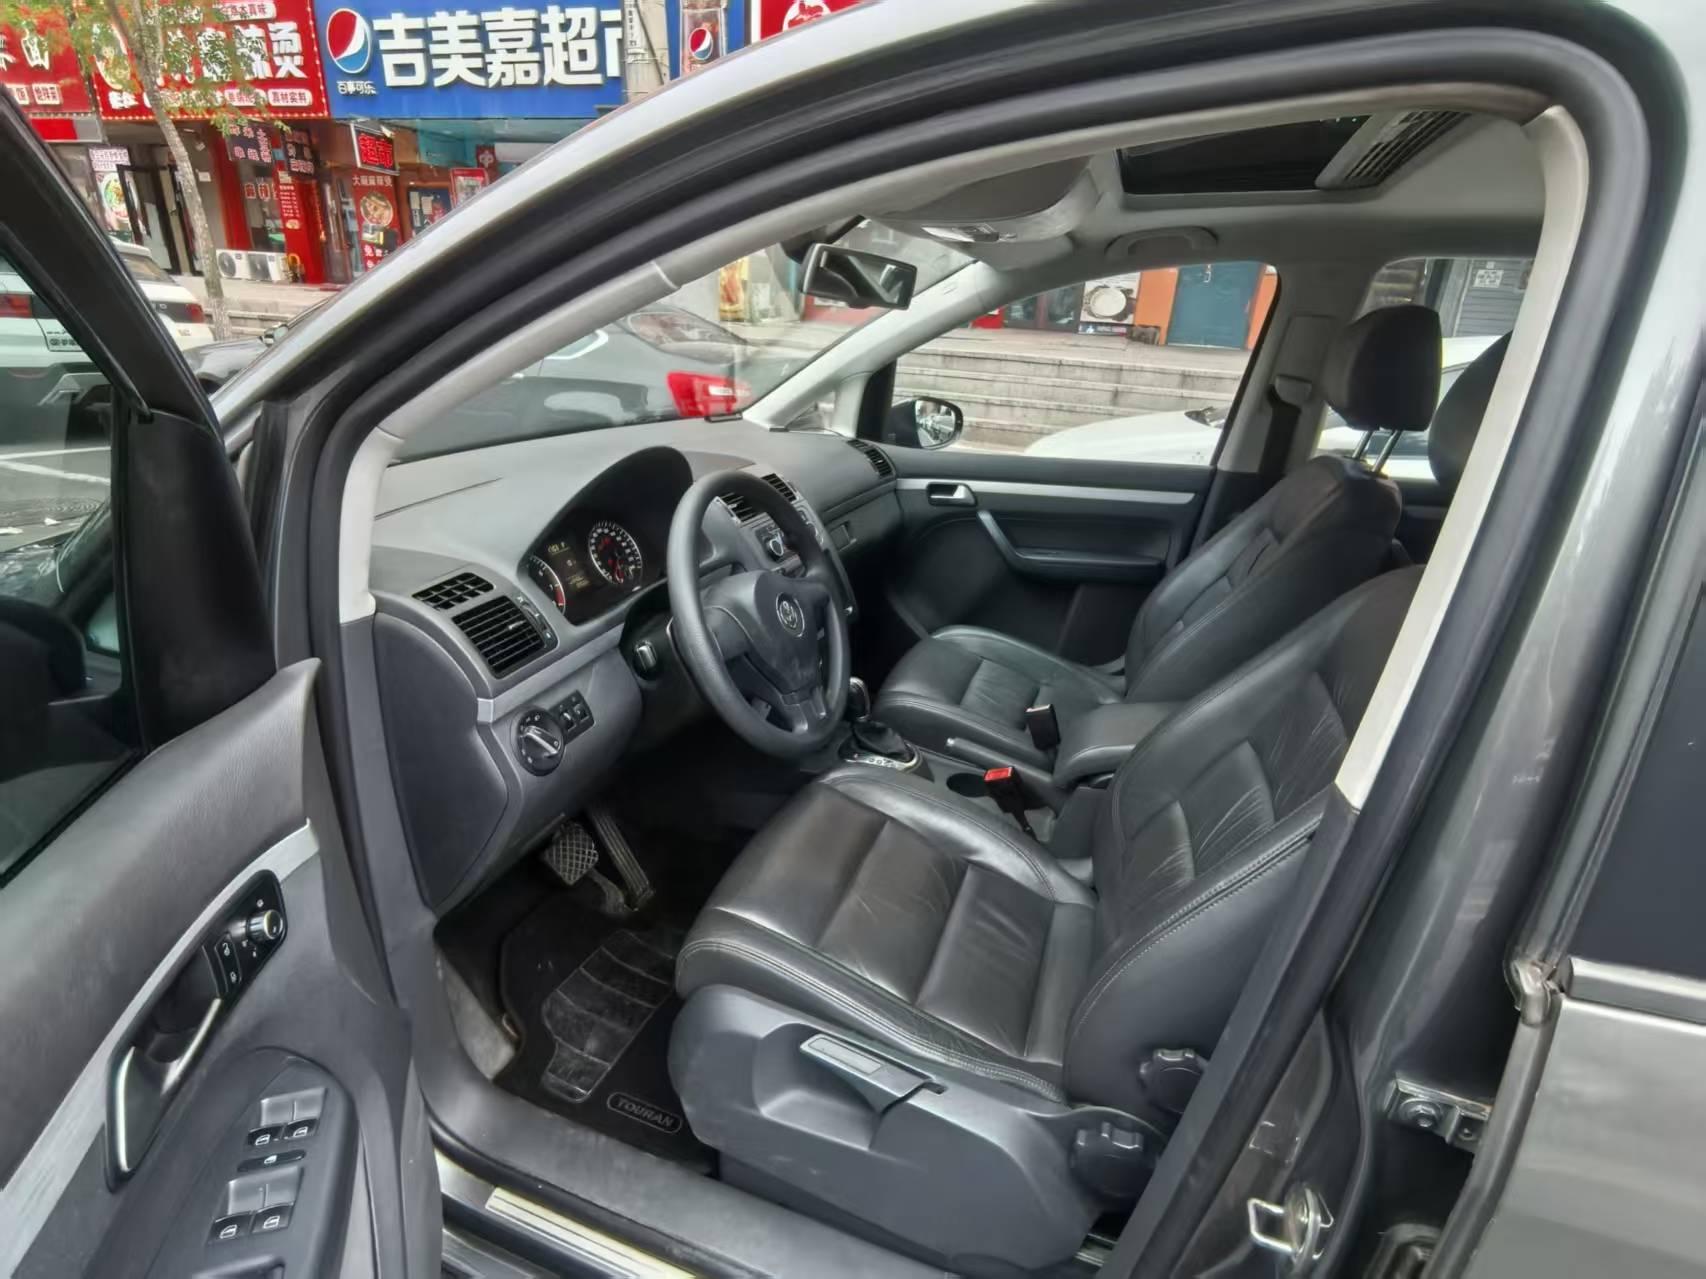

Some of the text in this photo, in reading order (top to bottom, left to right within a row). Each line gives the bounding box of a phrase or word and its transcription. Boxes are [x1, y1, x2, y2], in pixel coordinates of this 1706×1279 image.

[336, 80, 377, 95] 百事可乐
[617, 1098, 673, 1127] TOURAN
